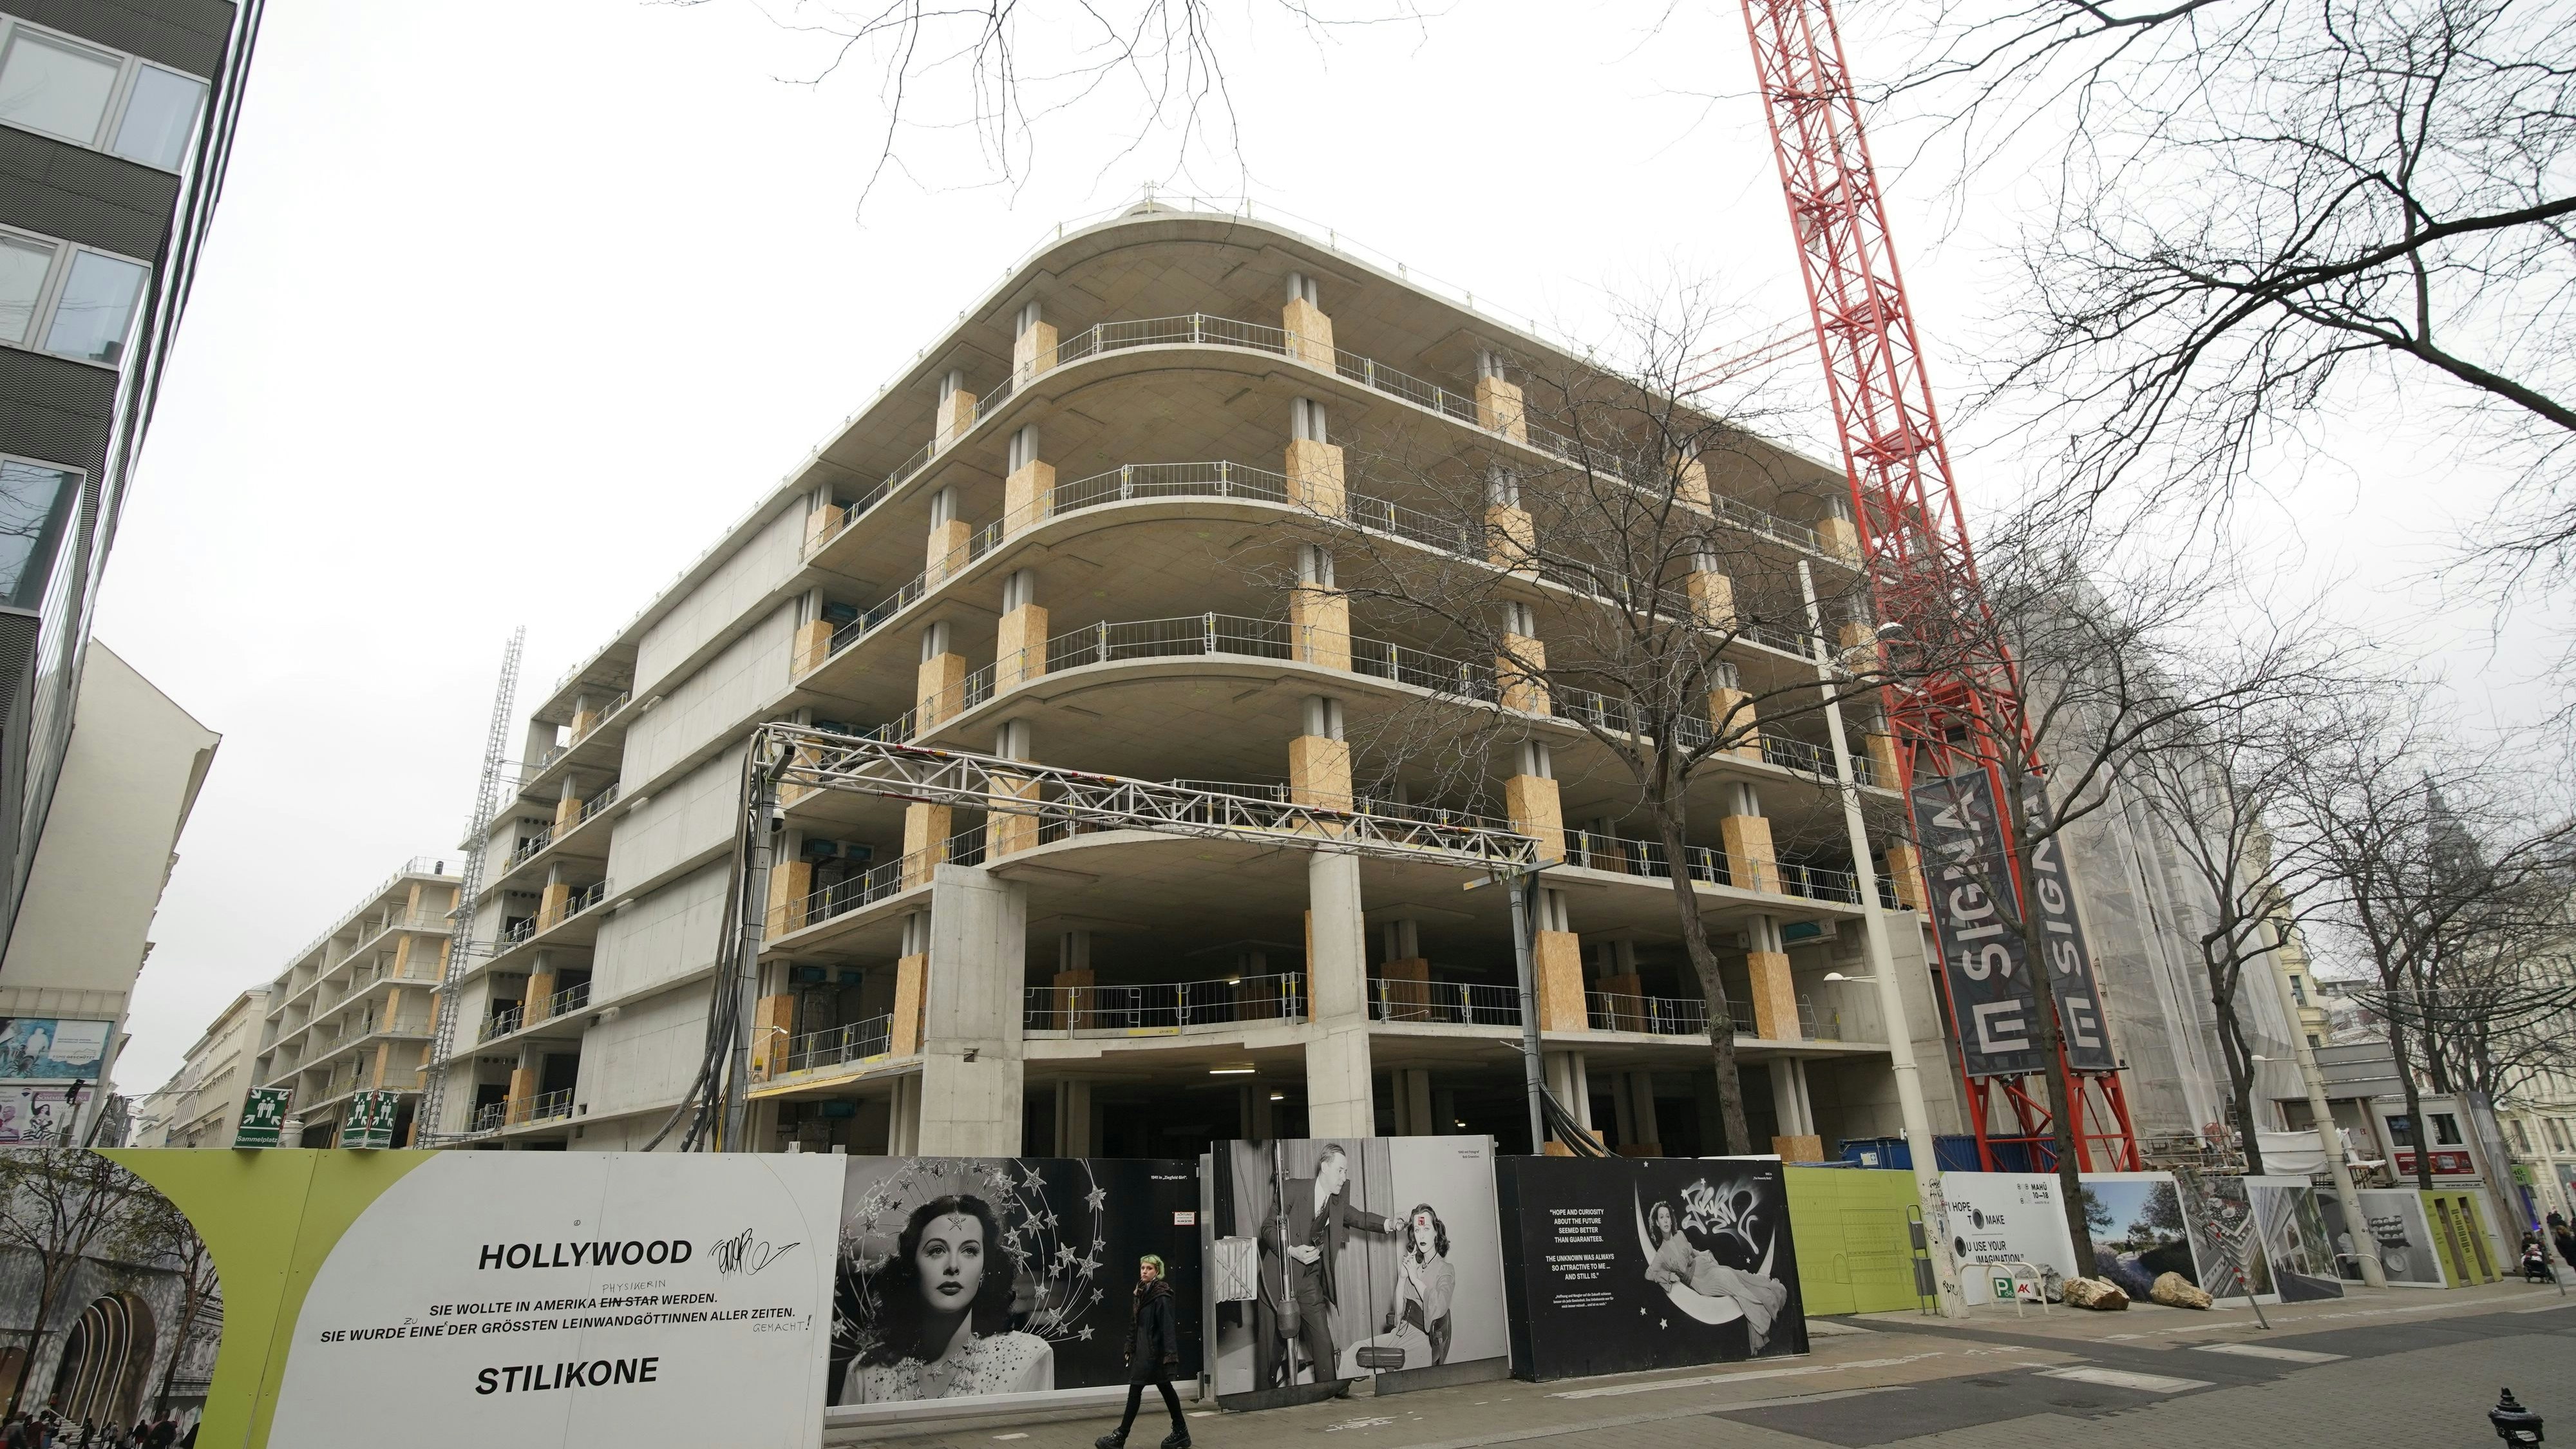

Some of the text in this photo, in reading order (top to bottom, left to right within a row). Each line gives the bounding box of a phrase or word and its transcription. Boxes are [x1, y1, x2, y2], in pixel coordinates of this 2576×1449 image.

[236, 1135, 278, 1144] Sammelplatz
[1953, 1202, 1972, 1212] HOPE
[1985, 1215, 2005, 1225] MAKE
[1974, 1242, 1987, 1251] USE
[1988, 1241, 2007, 1251] YOUR
[478, 1240, 692, 1270] HOLLYWOOD
[602, 1279, 666, 1294] PHYSIKERIN
[1995, 1279, 2008, 1296] P
[2018, 1283, 2031, 1293] AK
[429, 1293, 718, 1316] SIE WOLLTE IN AMERIKA EIN STAR WERDEN.
[320, 1307, 795, 1343] SIE WURDE EINE DER GRÖSSTEN LEINWANDGÖTTINNEN ALLER ZEITEN.
[475, 1357, 659, 1395] STILIKONE
